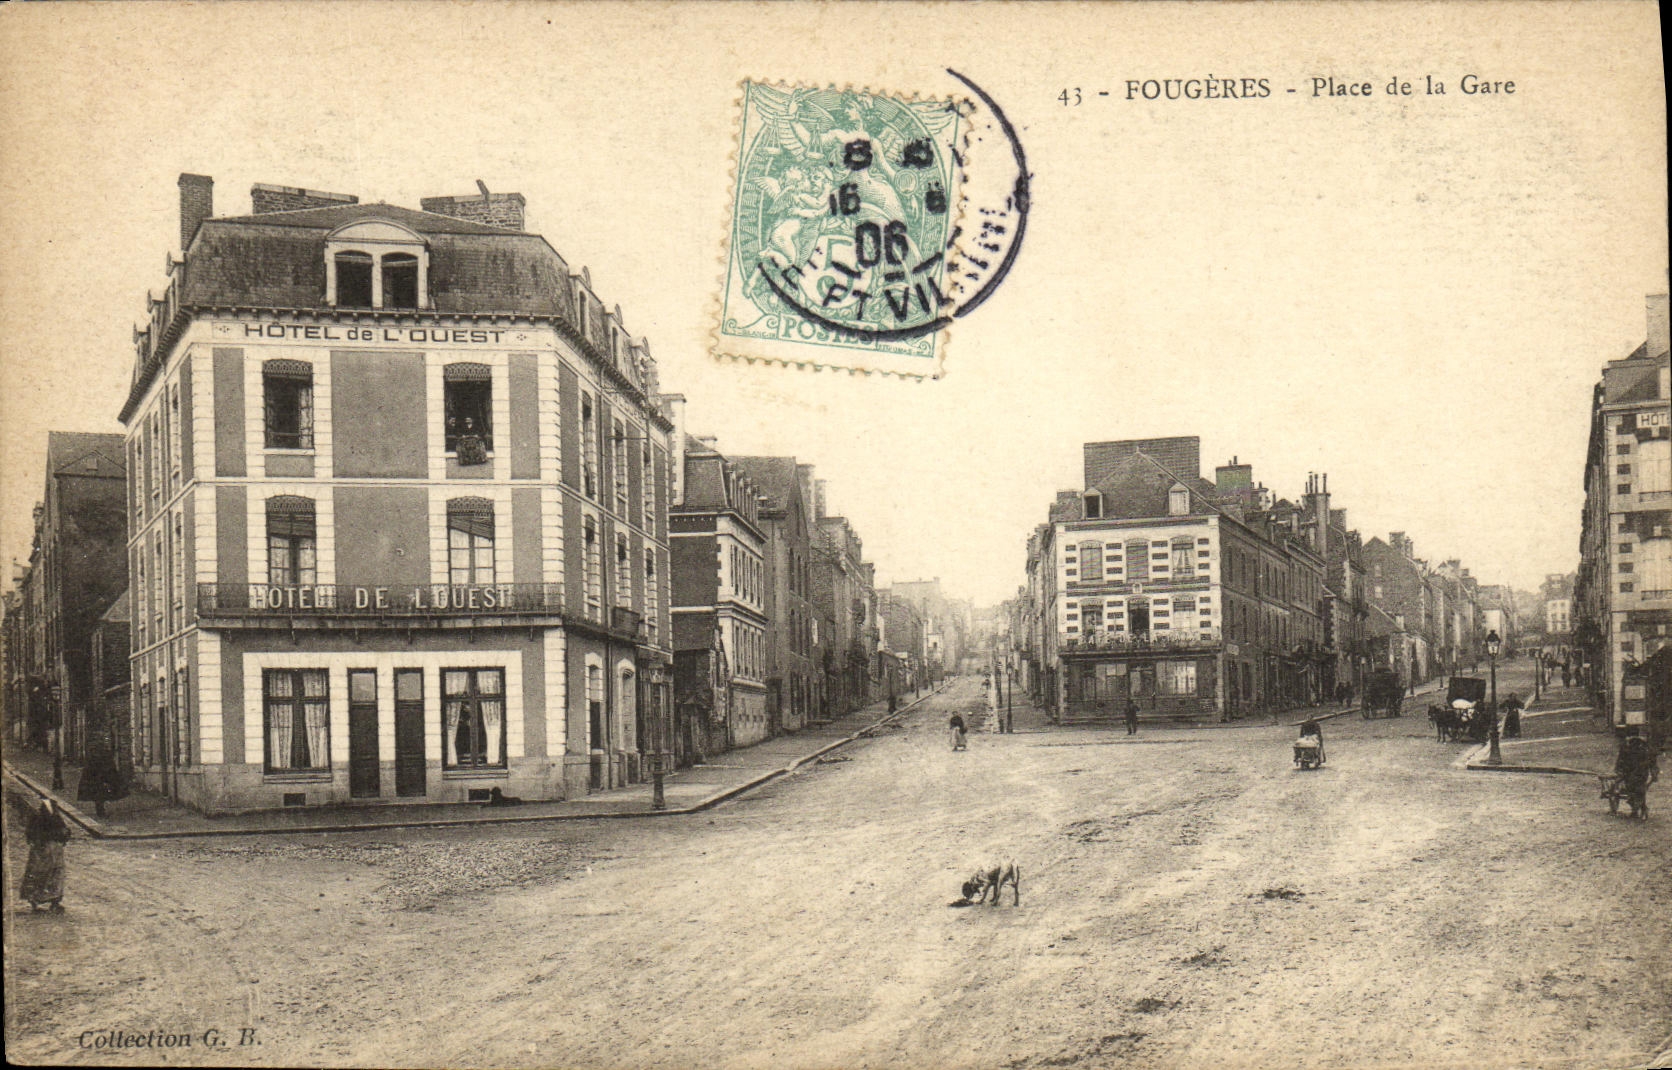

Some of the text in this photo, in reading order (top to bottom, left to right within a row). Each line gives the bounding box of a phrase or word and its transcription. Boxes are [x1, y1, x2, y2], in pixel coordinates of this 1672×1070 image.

[855, 220, 909, 268] 06
[244, 321, 505, 343] HÔTEL de L'OUEST
[252, 586, 325, 609] HOTEL
[355, 587, 390, 609] DE
